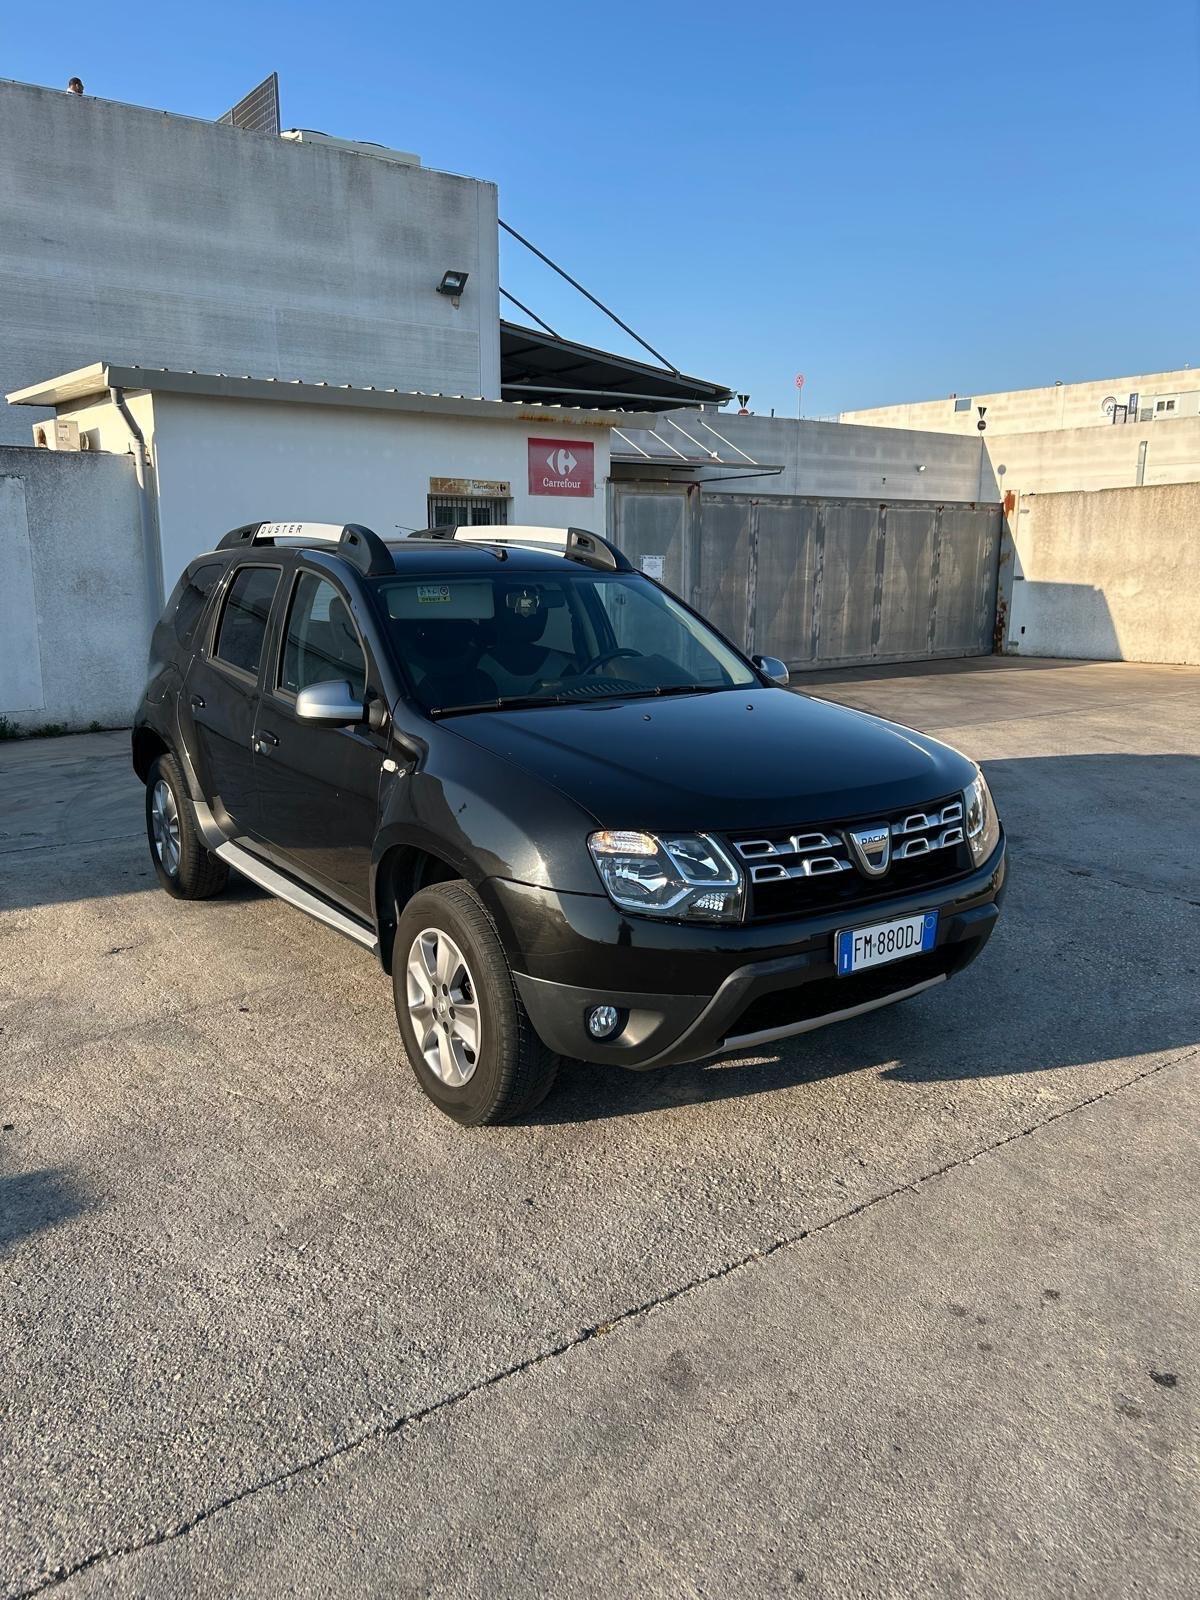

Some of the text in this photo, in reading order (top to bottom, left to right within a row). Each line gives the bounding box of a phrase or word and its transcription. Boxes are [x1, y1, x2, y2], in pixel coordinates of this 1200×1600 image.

[543, 477, 581, 489] Carrefour
[261, 524, 303, 535] DUSTER
[862, 834, 887, 845] DACIA
